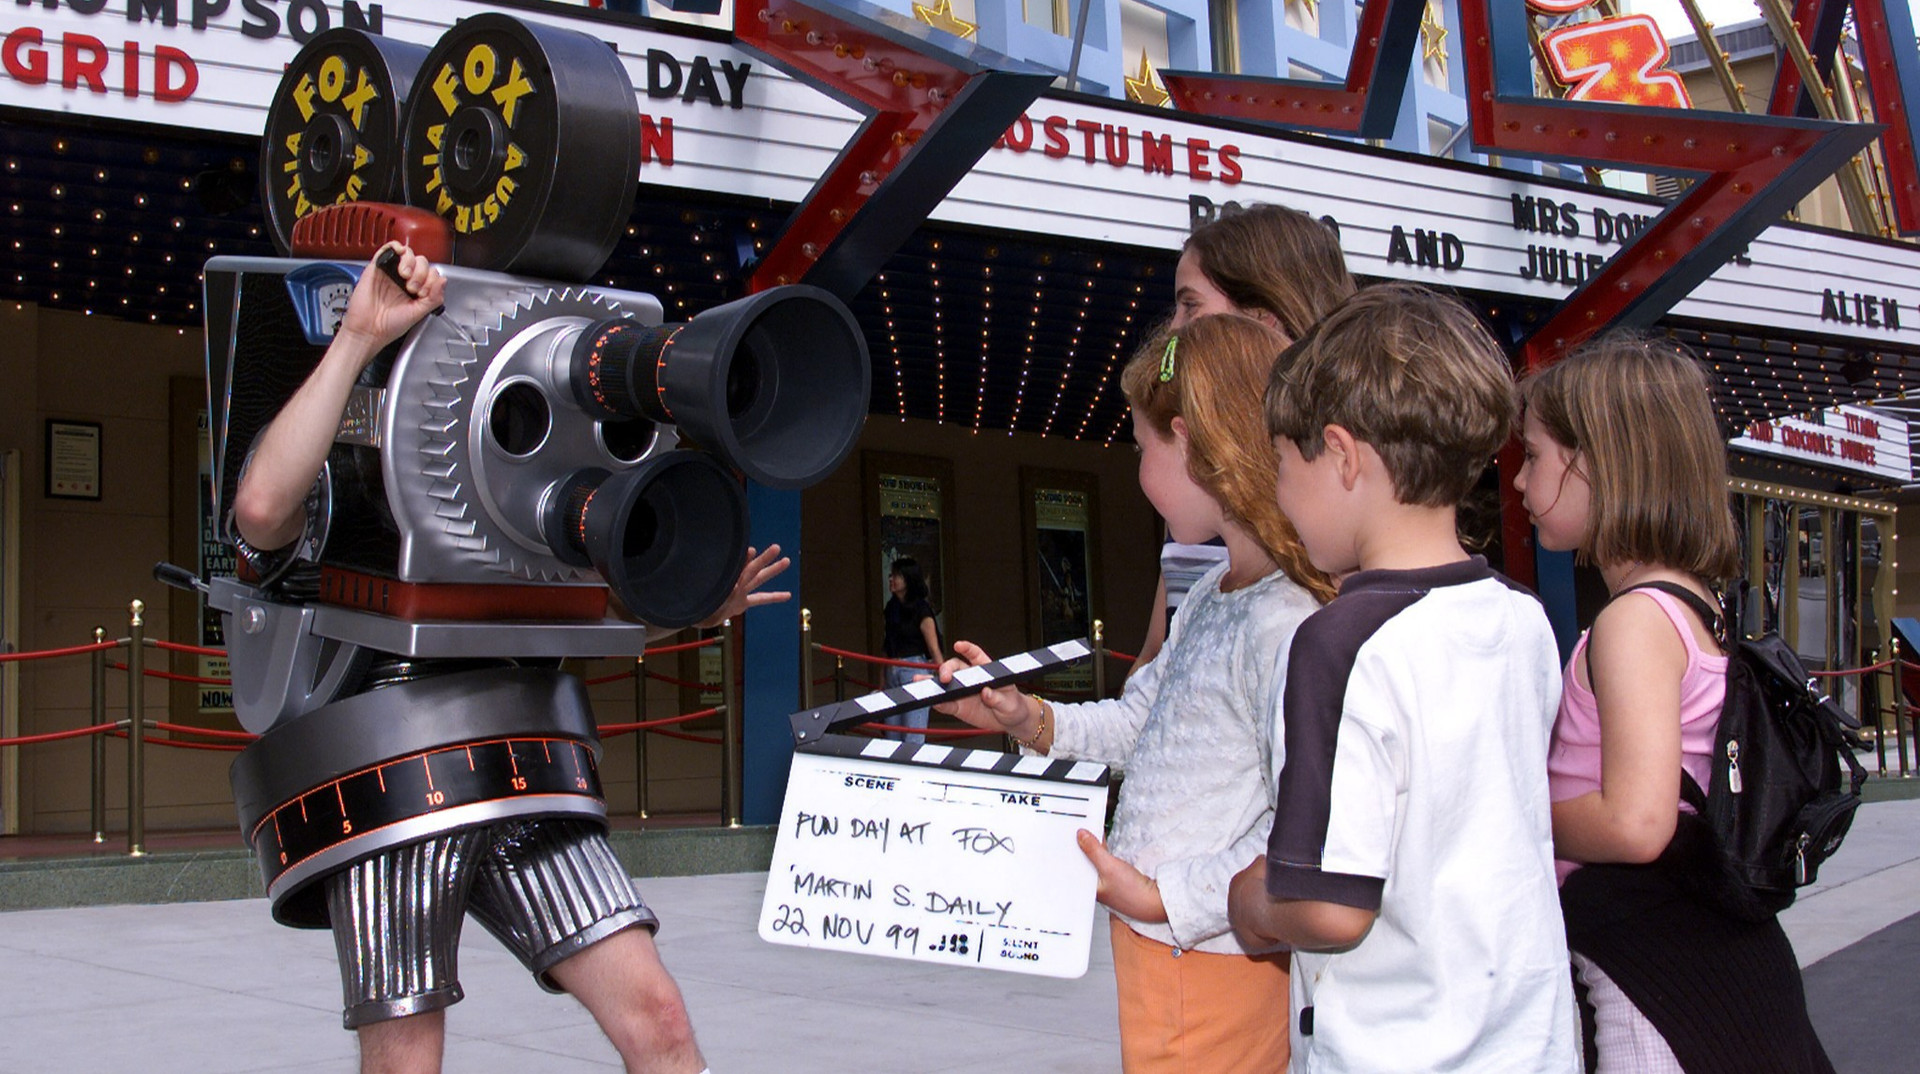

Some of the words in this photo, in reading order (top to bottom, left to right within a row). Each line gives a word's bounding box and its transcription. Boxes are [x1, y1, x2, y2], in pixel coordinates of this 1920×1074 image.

[2, 27, 199, 102] GRID
[432, 44, 536, 129] FOX
[647, 48, 751, 109] DAY
[293, 55, 379, 132] FOX
[992, 112, 1243, 185] OSTUMES
[423, 123, 524, 234] AUSTRALIA
[1511, 193, 1579, 238] MRS
[1387, 225, 1464, 271] AND
[1519, 244, 1613, 287] JULIE
[1820, 288, 1901, 331] ALIEN
[203, 542, 224, 556] THE
[201, 690, 234, 708] NOW
[342, 820, 353, 834] 5
[425, 791, 445, 805] 10
[511, 777, 528, 791] 15
[844, 776, 896, 791] SCENE
[1000, 793, 1042, 807] TAKE
[850, 818, 890, 853] DAY
[899, 821, 932, 845] AT
[951, 828, 1016, 855] FOX
[772, 904, 811, 937] 22
[822, 913, 875, 945] NOV
[885, 924, 921, 955] 99
[892, 884, 916, 908] S.
[924, 892, 1013, 927] DAILY
